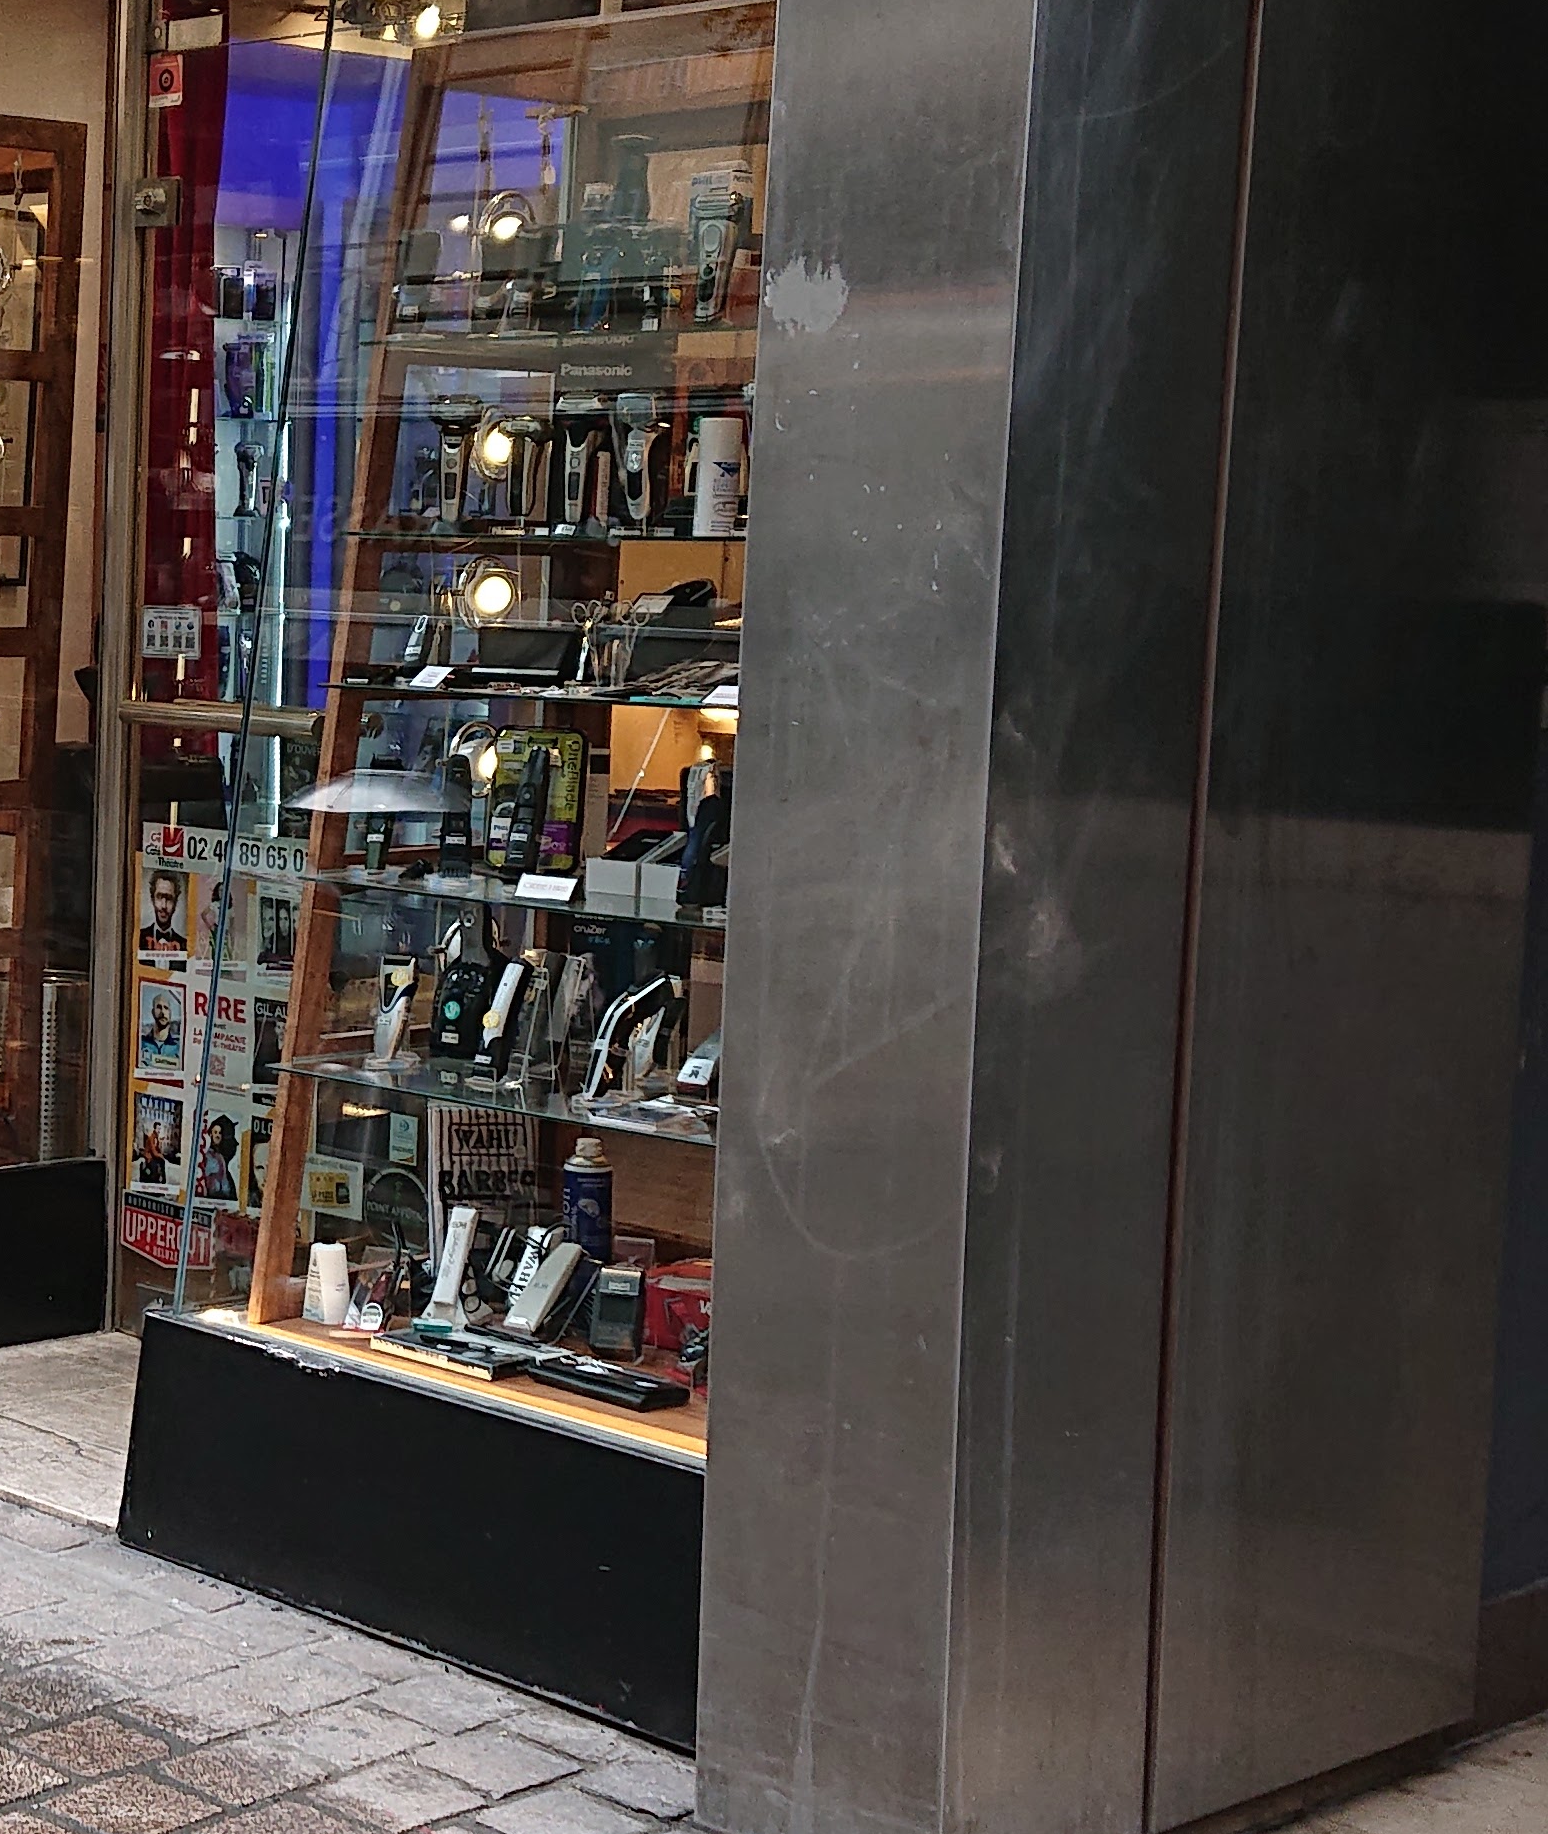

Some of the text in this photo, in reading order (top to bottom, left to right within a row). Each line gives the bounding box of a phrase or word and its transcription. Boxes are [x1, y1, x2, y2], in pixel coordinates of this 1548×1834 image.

[560, 363, 633, 378] Panasonic
[187, 836, 309, 873] 02 4 89 65 0
[194, 991, 247, 1024] RRE
